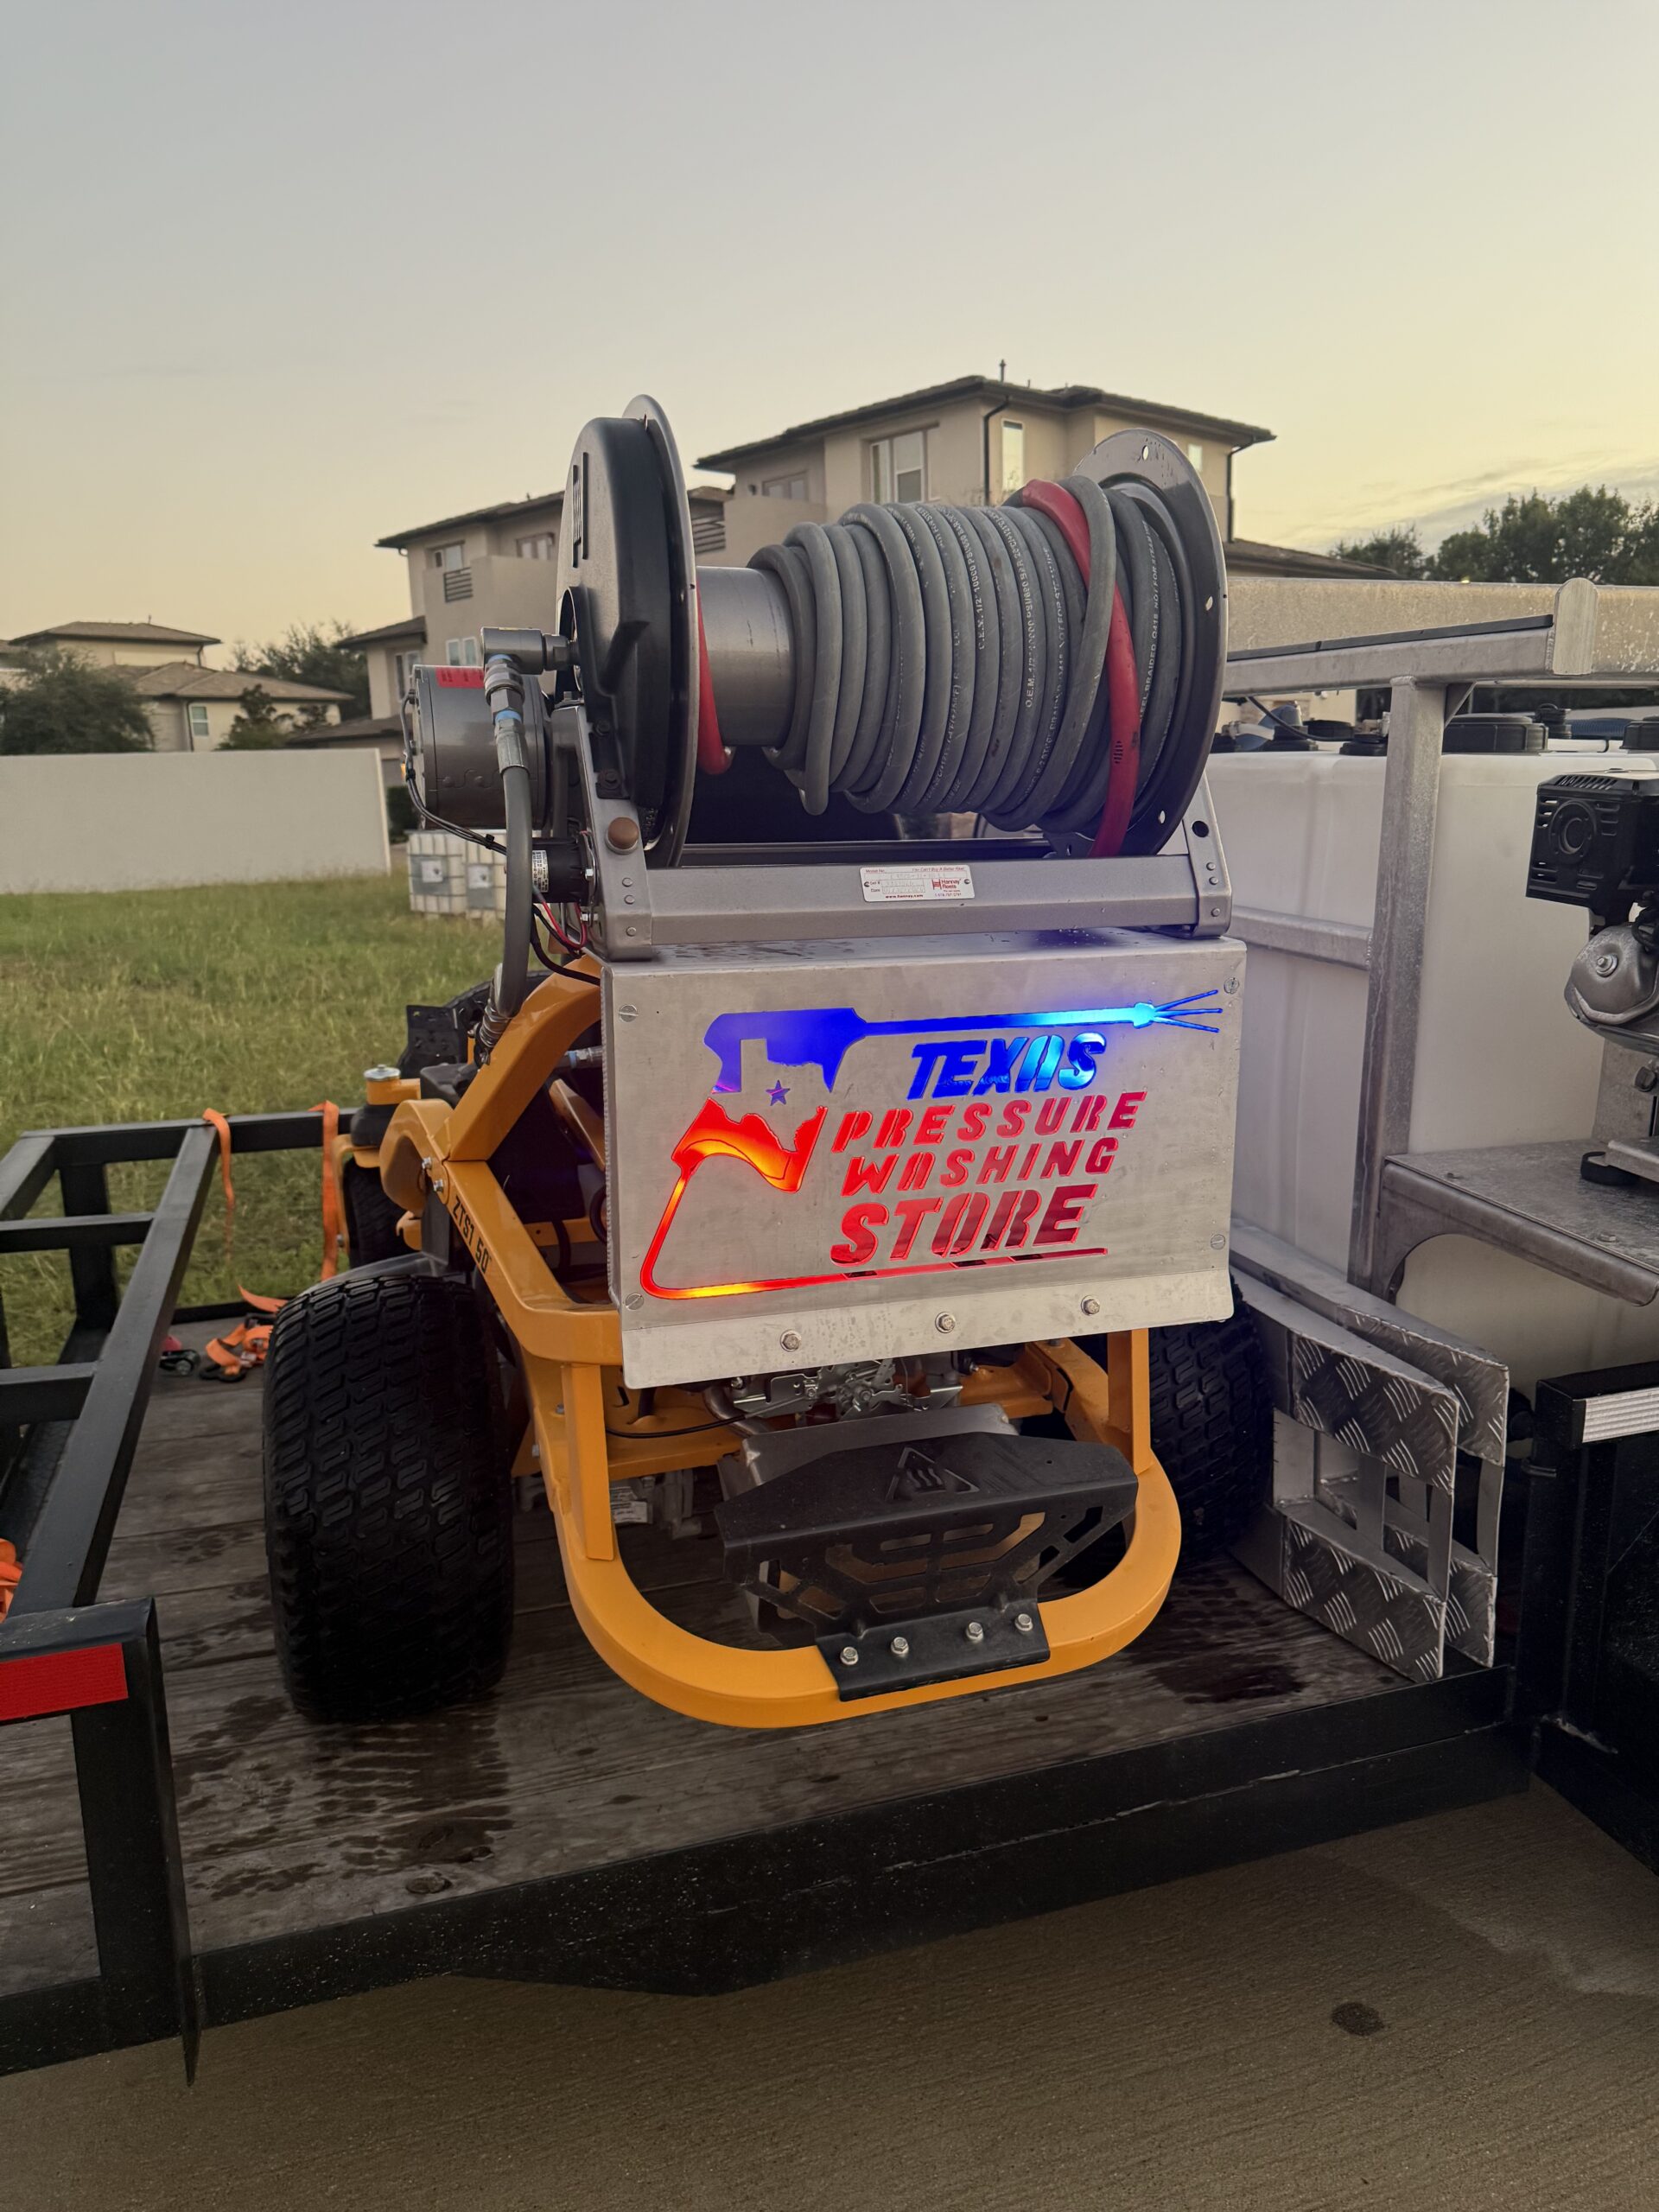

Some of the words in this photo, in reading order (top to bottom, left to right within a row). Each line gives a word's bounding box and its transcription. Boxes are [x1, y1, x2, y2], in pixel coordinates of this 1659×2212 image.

[1025, 674, 1035, 708] O.E.M.
[1145, 644, 1156, 691] BRAIDED
[906, 1032, 1107, 1101] TEXAS
[830, 1090, 1148, 1154] PRESSURE
[840, 1136, 1119, 1197] WASHING
[830, 1183, 1099, 1268] STORE
